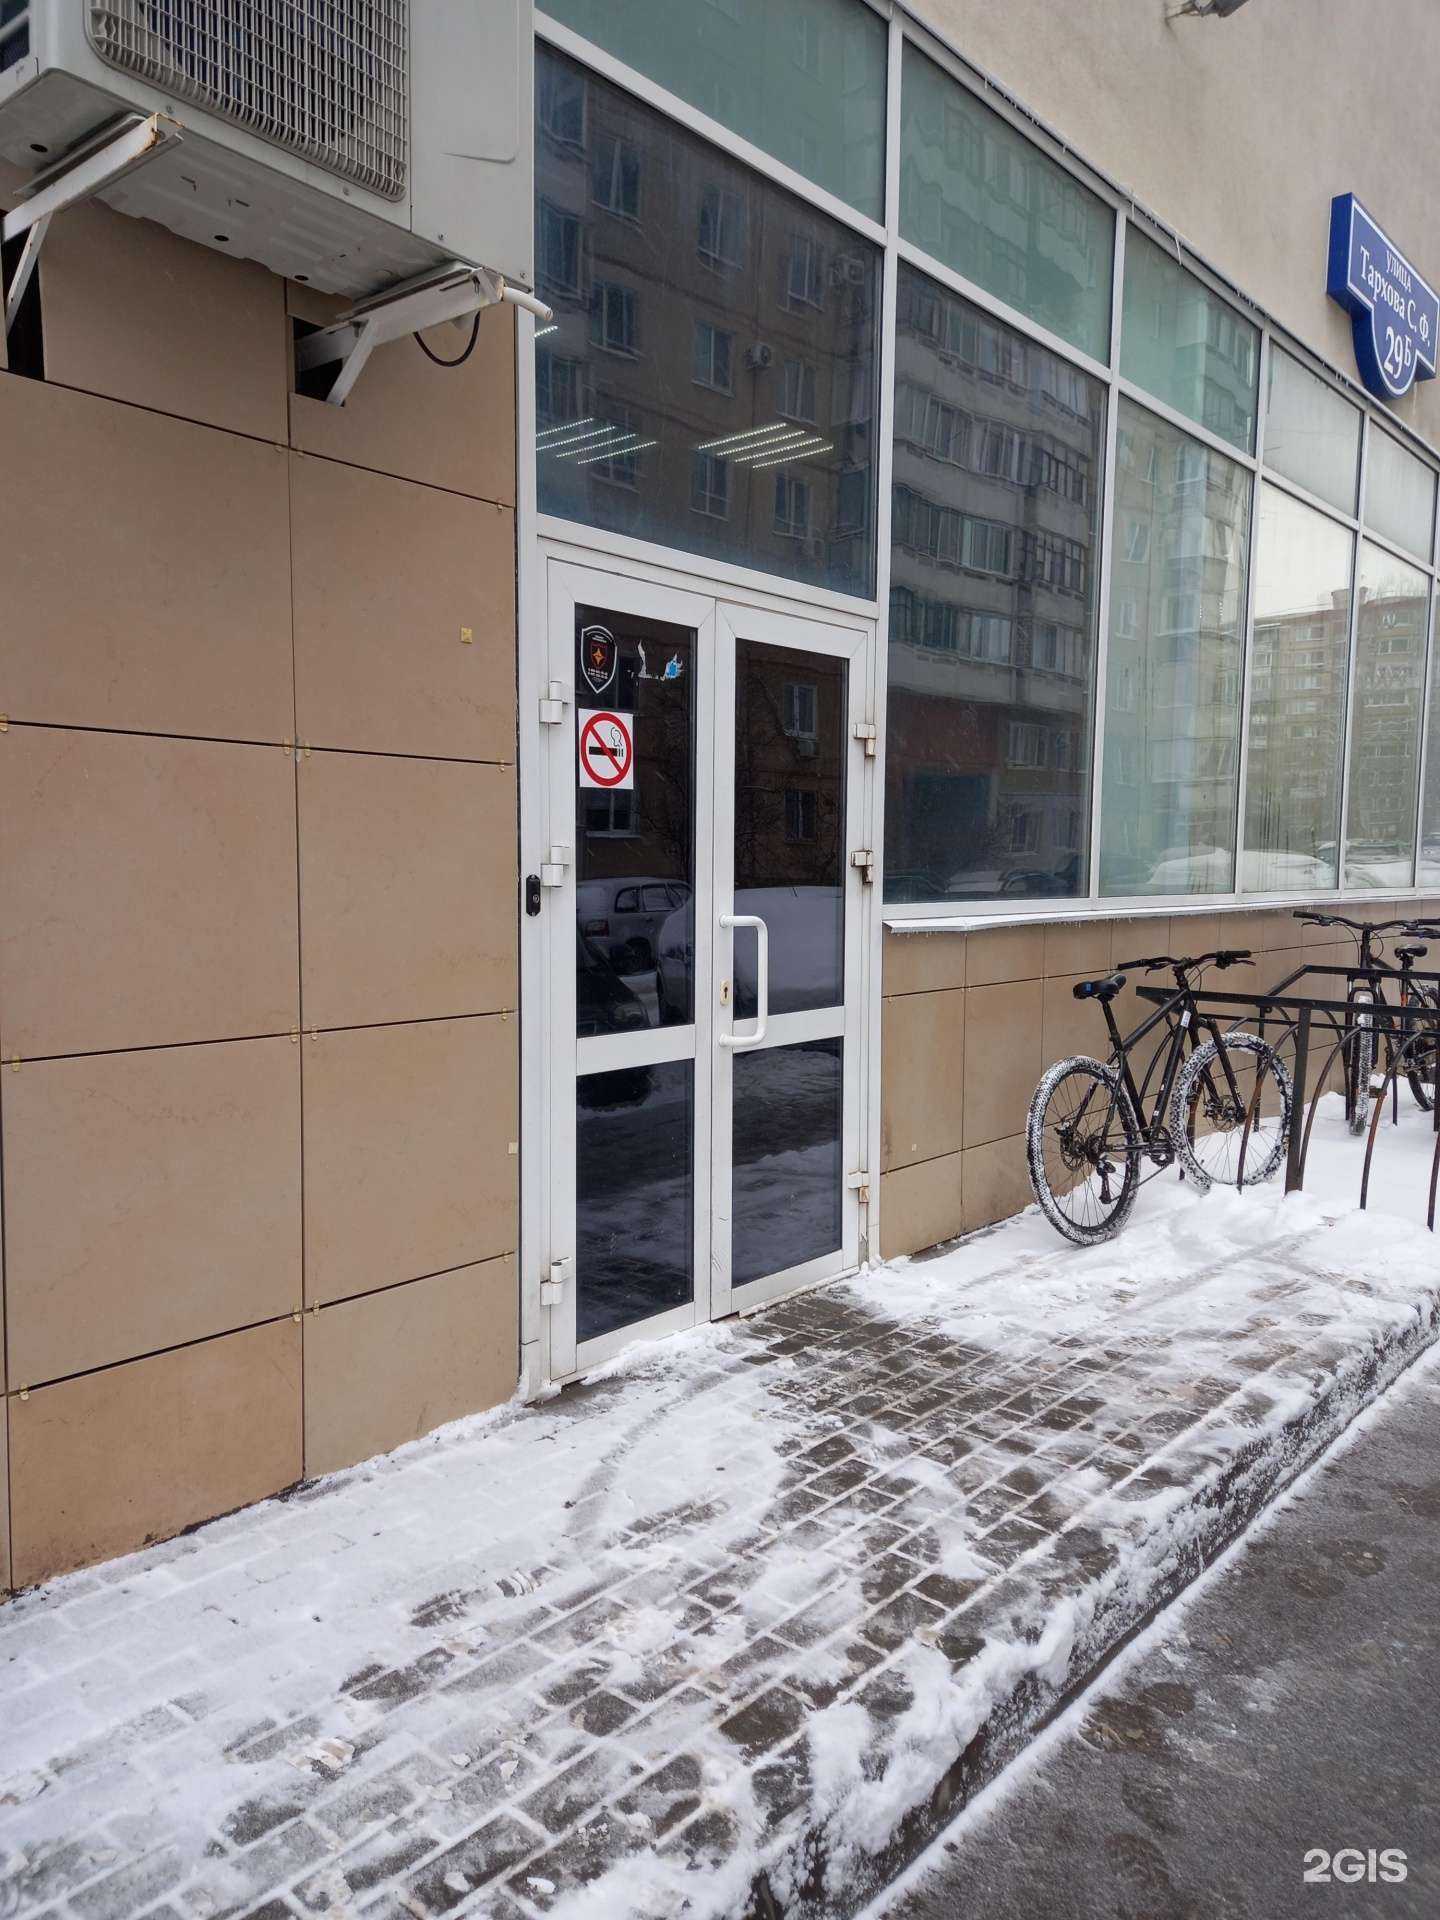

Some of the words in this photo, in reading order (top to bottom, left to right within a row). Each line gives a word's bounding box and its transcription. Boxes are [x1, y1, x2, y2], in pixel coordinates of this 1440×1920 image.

[1360, 245, 1405, 320] Тархова
[1407, 299, 1417, 333] С.
[1419, 313, 1430, 347] Ф.
